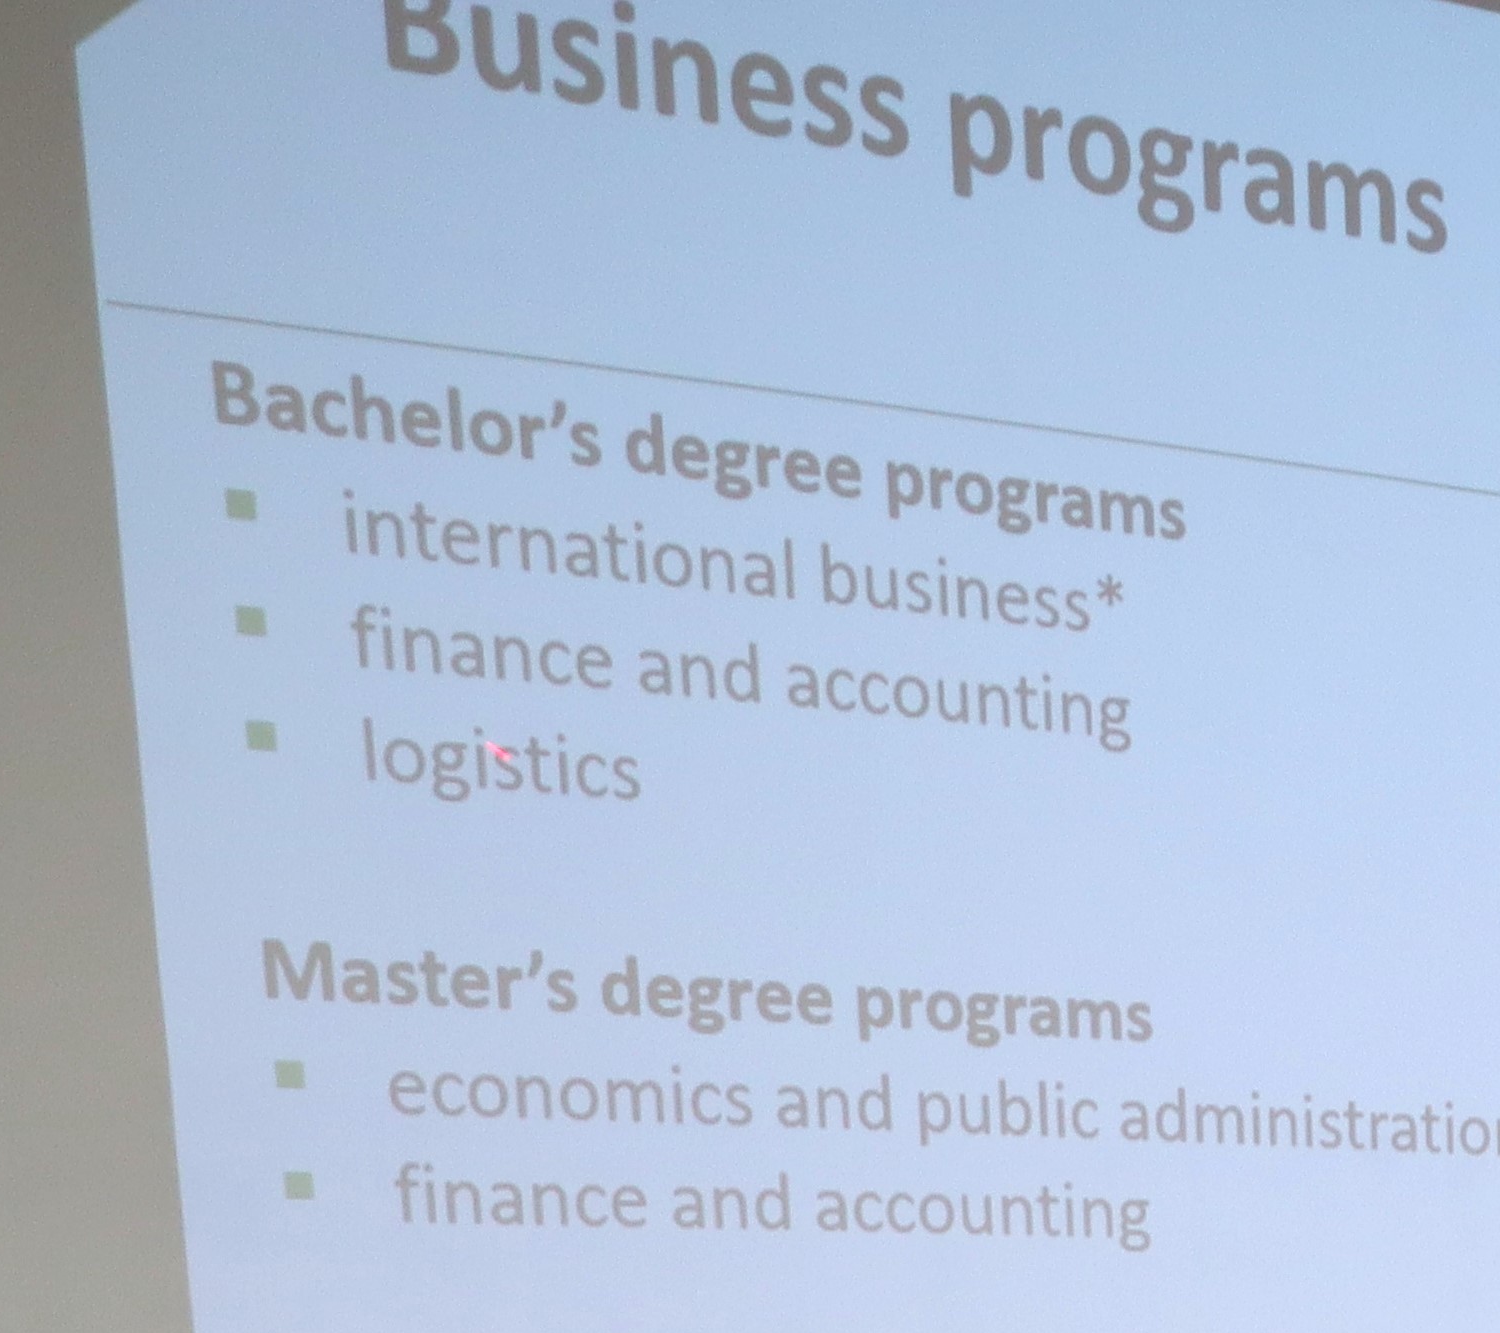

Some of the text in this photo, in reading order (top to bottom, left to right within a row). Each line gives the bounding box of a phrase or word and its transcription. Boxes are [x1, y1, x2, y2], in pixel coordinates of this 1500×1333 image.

[385, 0, 1450, 256] Business programs
[623, 409, 864, 511] degree
[884, 446, 1189, 544] programs
[340, 488, 798, 604] international
[351, 604, 1134, 755] finance and accounting
[362, 716, 644, 806] logistics
[600, 956, 835, 1036] degree
[855, 979, 1156, 1048] programs
[387, 1061, 755, 1129] economics
[775, 1066, 894, 1134] and
[916, 1075, 1102, 1148] public
[394, 1162, 1153, 1255] finance and accounting
